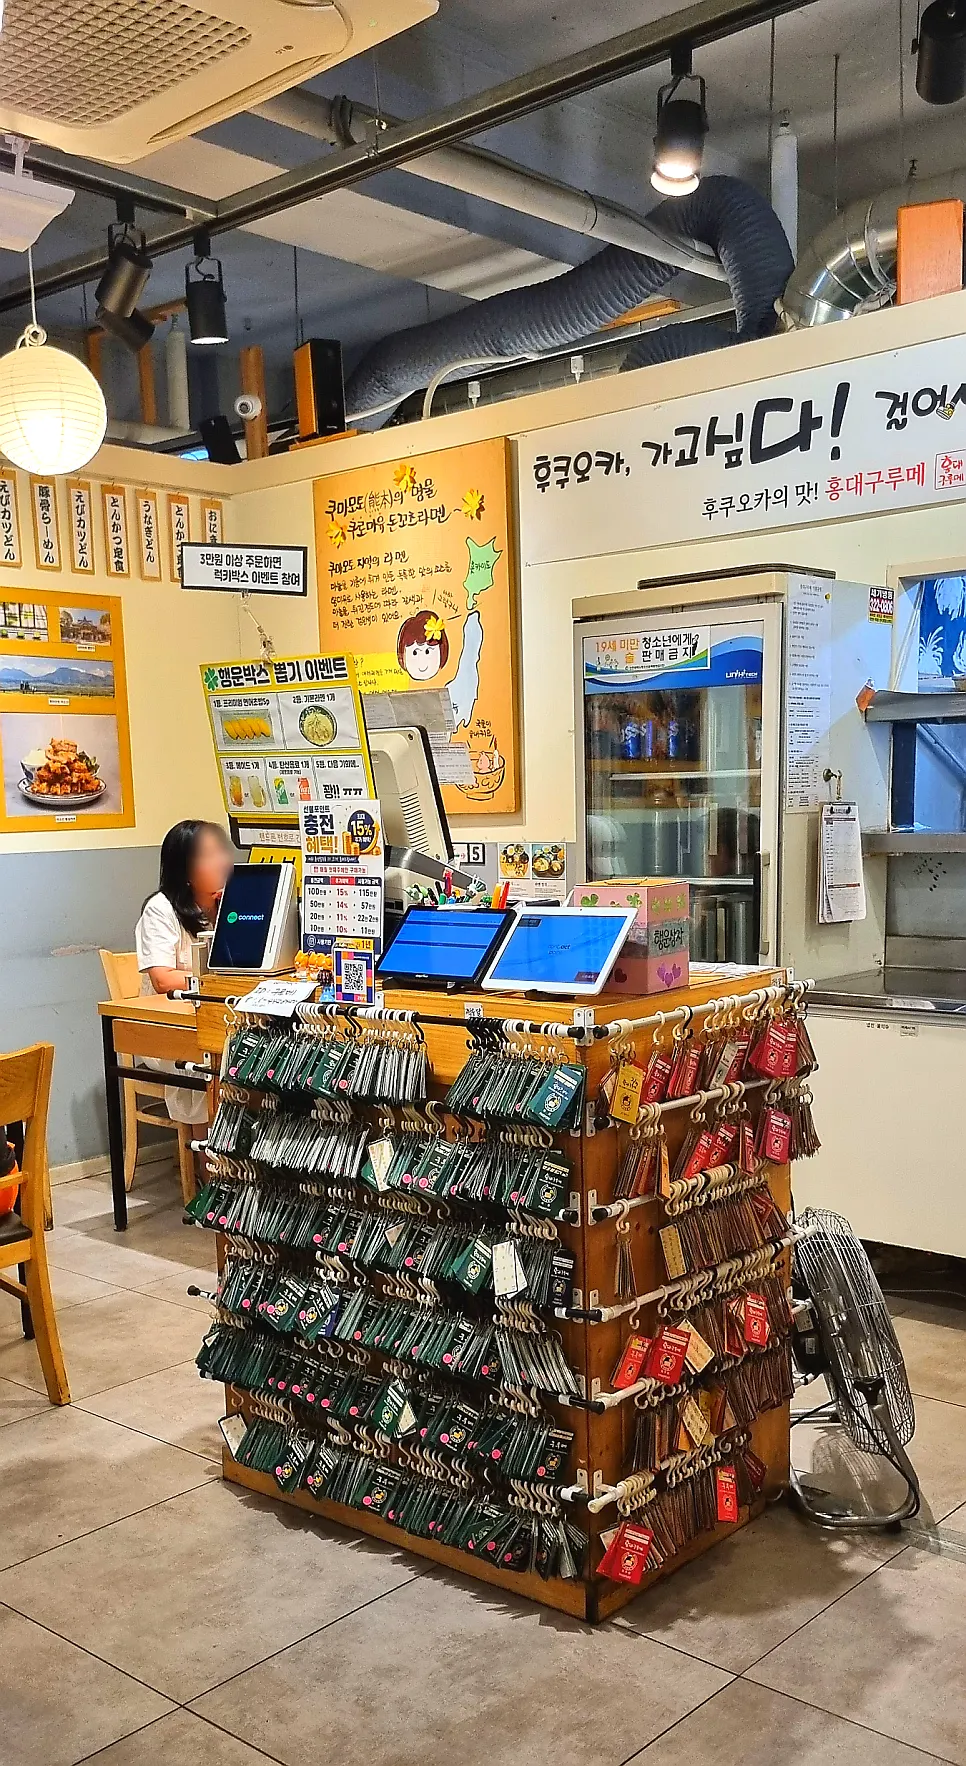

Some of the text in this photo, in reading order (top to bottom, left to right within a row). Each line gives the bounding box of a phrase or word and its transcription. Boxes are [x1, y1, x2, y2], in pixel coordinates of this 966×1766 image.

[533, 450, 631, 494] 후쿠오카,
[941, 455, 963, 473] 홍대
[411, 478, 437, 502] 명물
[938, 473, 964, 486] 구루메
[702, 461, 925, 521] 후쿠오카의 맛! 홍대구루메
[0, 480, 15, 560] えびカツどん
[38, 486, 54, 563] 豚骨らーめん
[75, 491, 88, 567] えびカツどん
[110, 496, 124, 572] とんかつ定食
[143, 501, 154, 563] うなぎどん
[200, 554, 282, 569] 3만원 이상 주문하면
[384, 550, 409, 566] 라멘
[214, 569, 300, 586] 럭키박스 이벤트 참여
[596, 633, 692, 653] 19세 미만 청소년에게
[218, 664, 270, 688] 행운박스
[273, 660, 303, 684] 뽑기
[305, 657, 348, 680] 이벤트
[304, 814, 335, 835] 충전
[351, 820, 373, 836] 15%
[306, 836, 338, 854] 혜택!
[472, 847, 480, 861] 5
[337, 901, 348, 909] 14%
[654, 927, 684, 950] 행운상자
